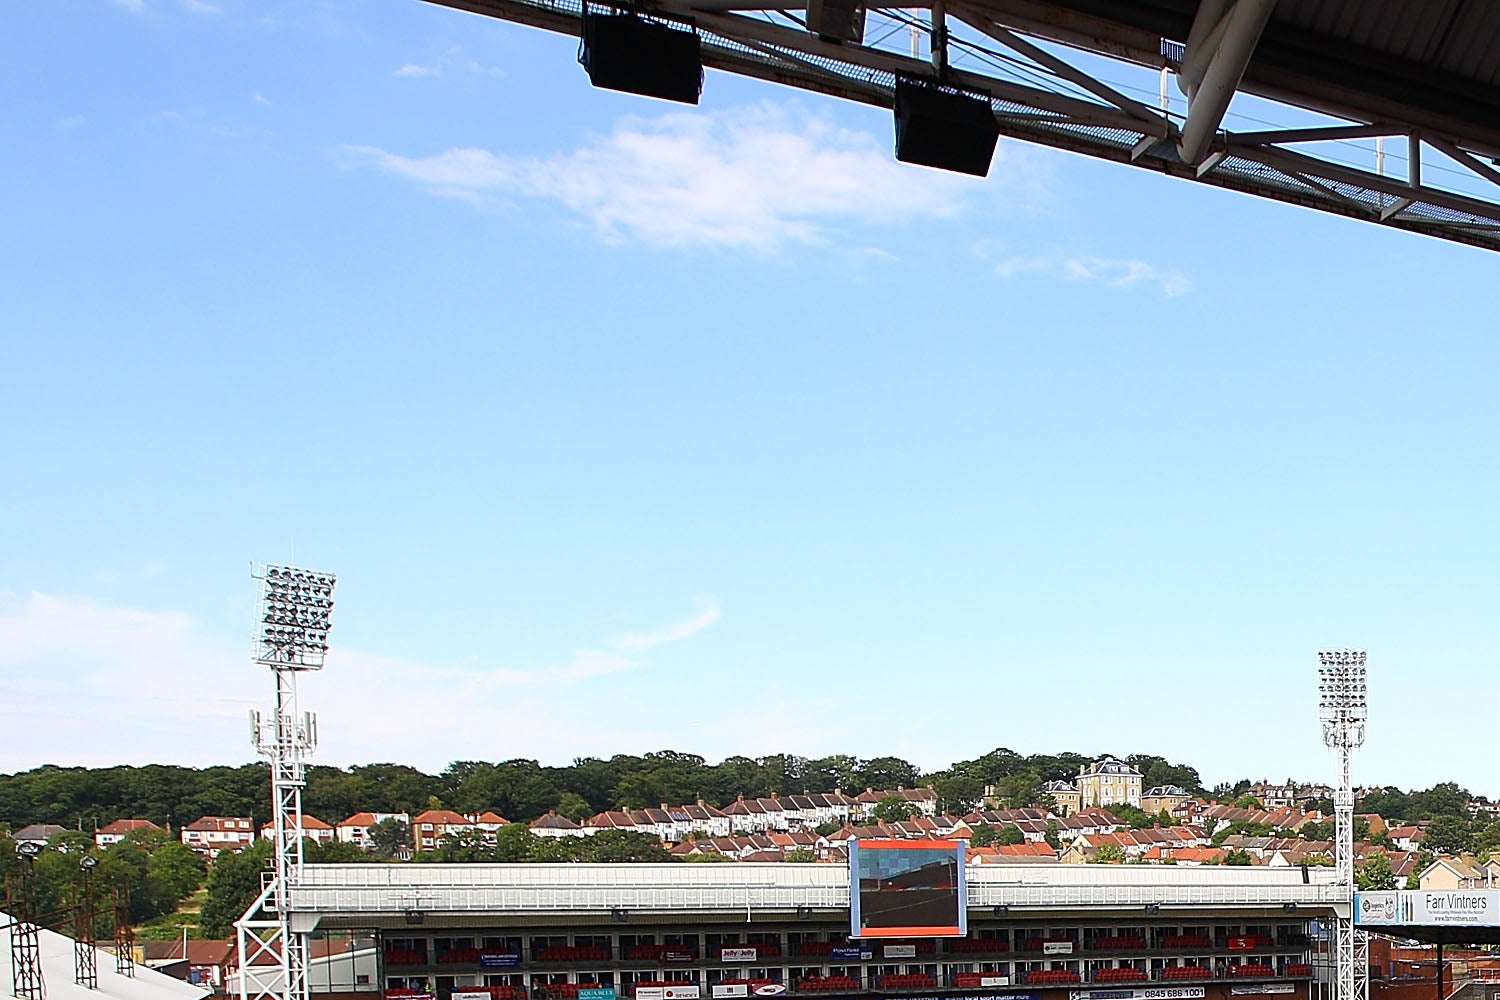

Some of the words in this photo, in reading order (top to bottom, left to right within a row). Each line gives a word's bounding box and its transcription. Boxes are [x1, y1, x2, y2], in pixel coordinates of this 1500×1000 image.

[1426, 894, 1446, 908] Farr
[1448, 894, 1486, 908] Vintners
[1145, 990, 1165, 998] 0845
[1168, 990, 1182, 998] 686
[1186, 988, 1204, 996] 1001
